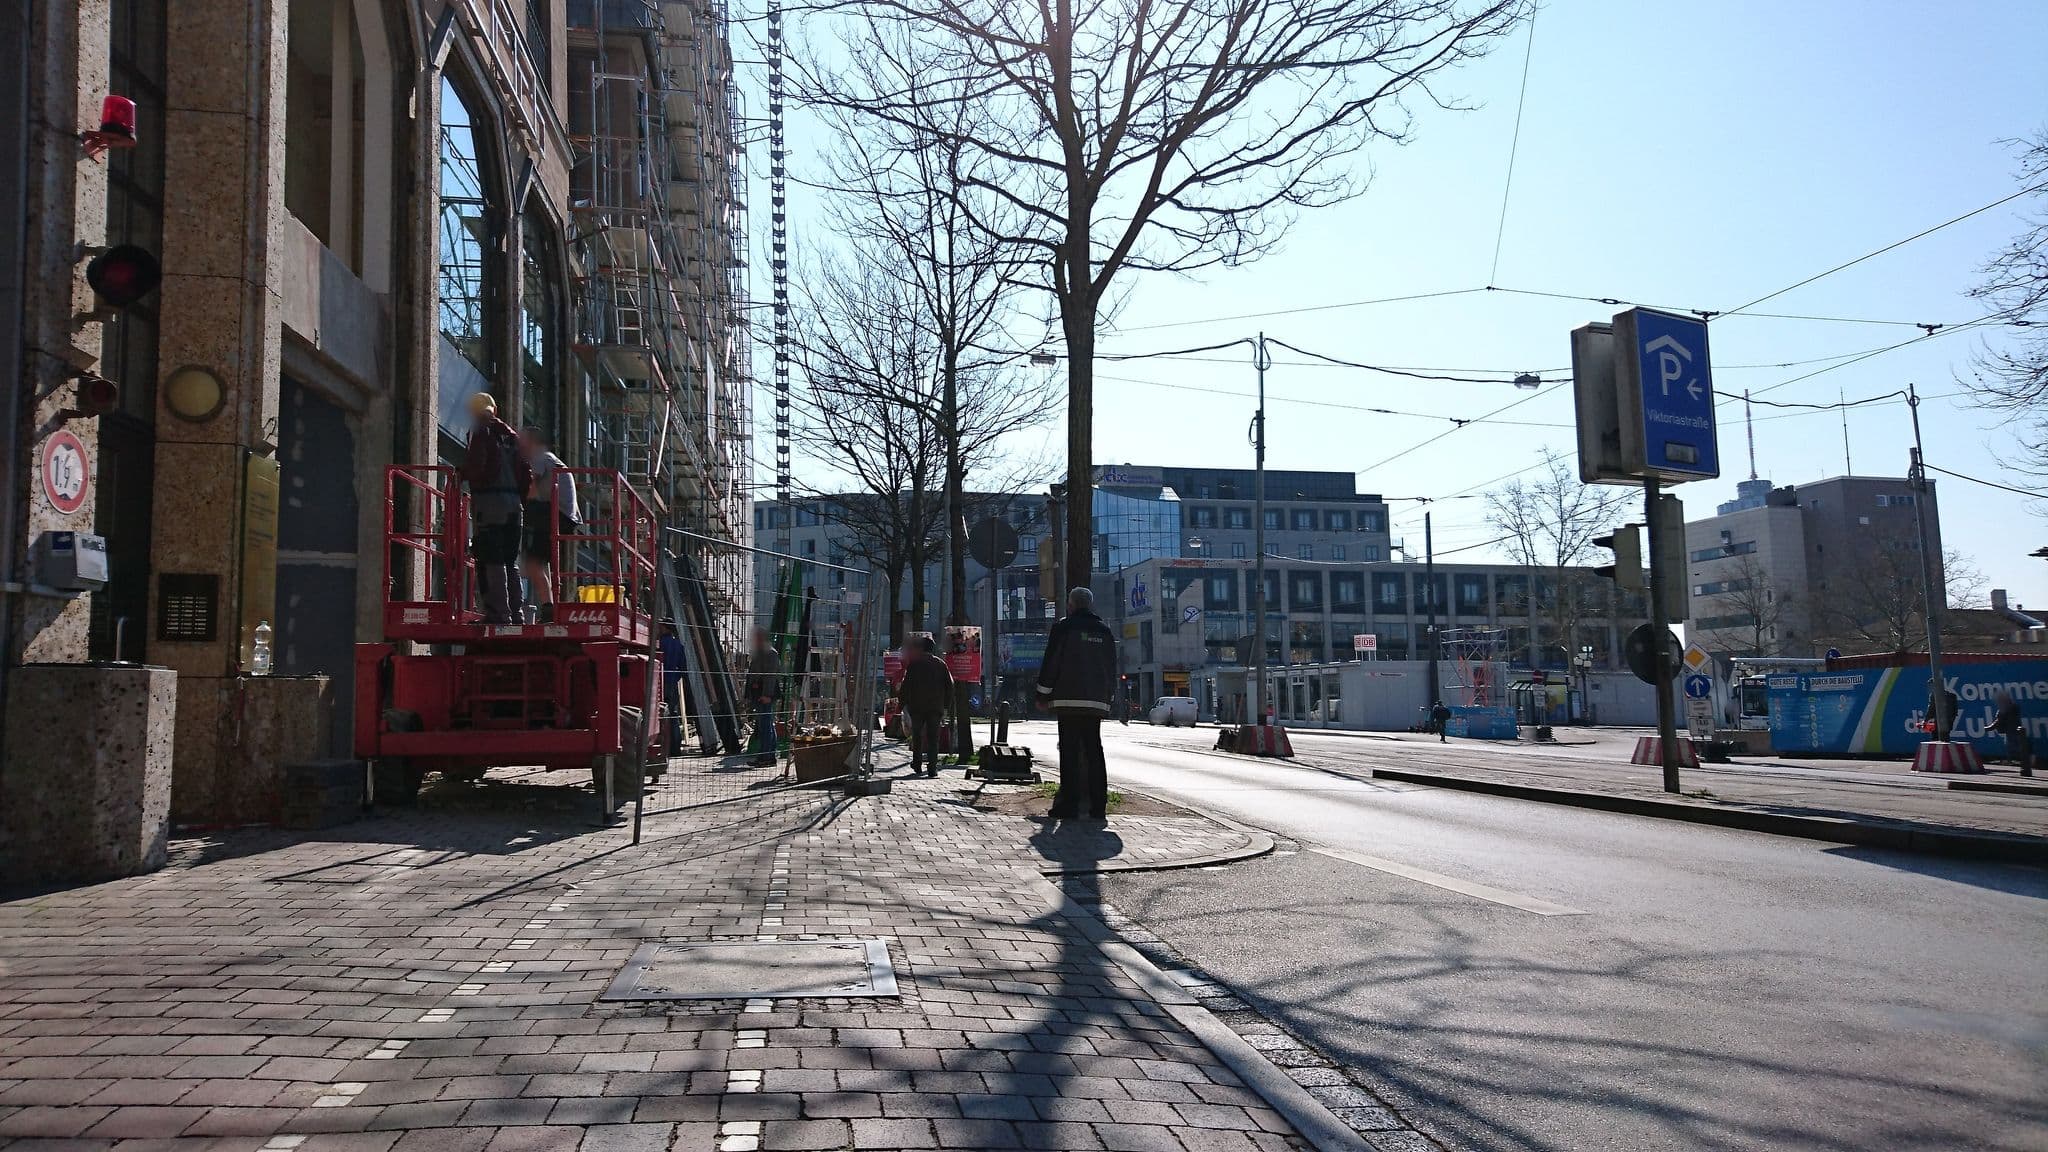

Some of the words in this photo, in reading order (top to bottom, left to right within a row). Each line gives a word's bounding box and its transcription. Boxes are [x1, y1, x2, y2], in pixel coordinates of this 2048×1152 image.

[1659, 351, 1682, 396] P
[1647, 408, 1709, 430] Viktoriastraße
[568, 610, 607, 623] 4444
